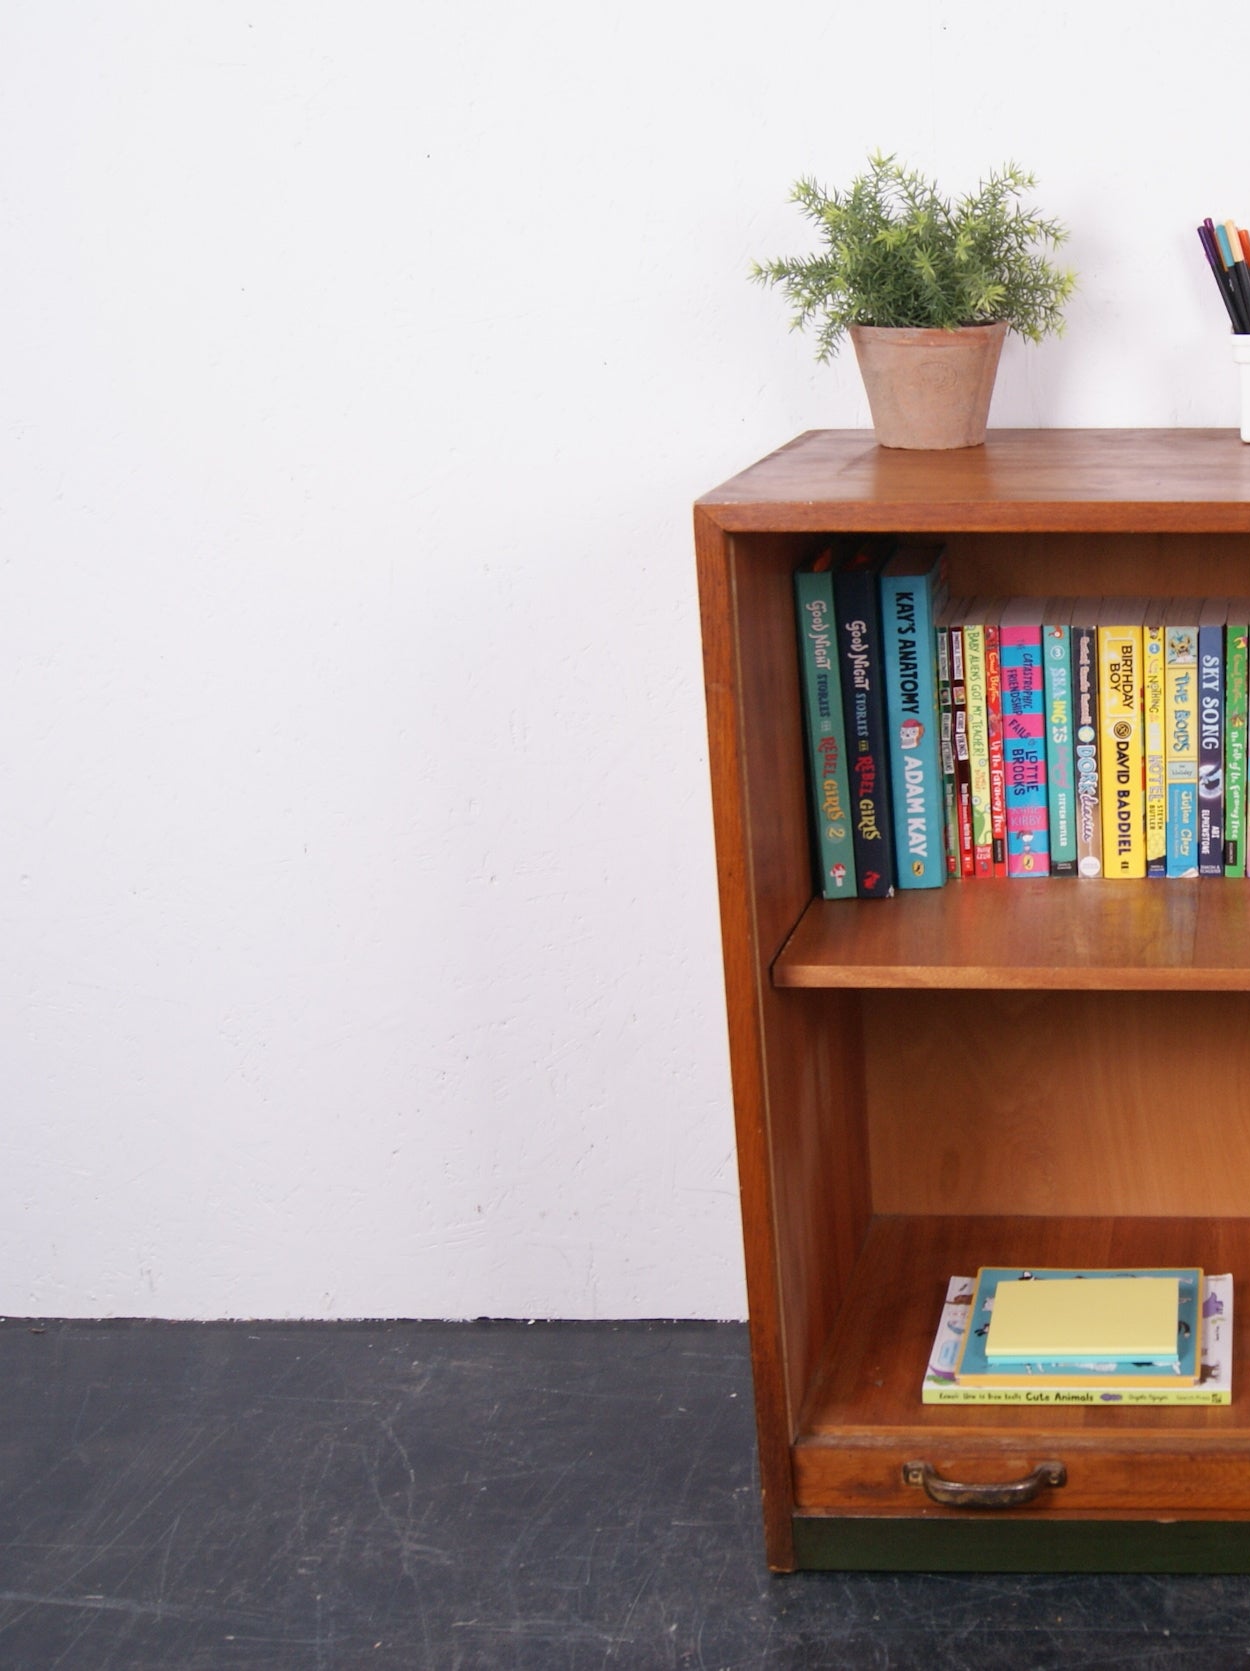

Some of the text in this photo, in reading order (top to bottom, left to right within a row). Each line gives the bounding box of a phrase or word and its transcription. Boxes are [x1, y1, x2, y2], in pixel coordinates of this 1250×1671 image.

[896, 592, 920, 714] KAY'S ANATOMY
[968, 631, 985, 757] BABY ALIENS GOT MY TEACHER!
[1007, 669, 1023, 716] FRIENDSHIP
[1022, 652, 1033, 709] CATASTROPHIC
[1110, 663, 1121, 692] BOY
[1121, 645, 1134, 710] BIRTHDAY
[856, 693, 869, 737] STORIES
[1173, 672, 1190, 752] THE BOLDS
[1202, 654, 1220, 750] SKY SONG
[1008, 718, 1031, 739] FAILS
[1052, 726, 1067, 744] IS
[818, 736, 838, 778] REBEL
[828, 827, 845, 838] 2
[854, 755, 876, 797] REBEL
[991, 769, 1003, 812] Faraway
[1012, 748, 1025, 796] BROOKS
[1025, 750, 1039, 793] LOTTIE
[1076, 744, 1098, 795] DORK
[1149, 754, 1164, 802] HOTEL
[904, 755, 928, 858] ADAM KAY
[1011, 815, 1041, 826] KIRBY
[1058, 792, 1067, 847] STEVEN BUTLER
[1080, 794, 1098, 843] diaries
[1116, 741, 1131, 856] DAVID BADDIEL
[1229, 785, 1241, 819] Faraway
[993, 815, 1003, 832] Tree
[1180, 791, 1192, 857] Julian Clary
[1201, 809, 1211, 855] ELPHINSTONE
[1211, 825, 1220, 839] ABI
[1231, 819, 1241, 839] Tree
[1026, 1392, 1050, 1401] Cute
[1054, 1392, 1094, 1402] Animals
